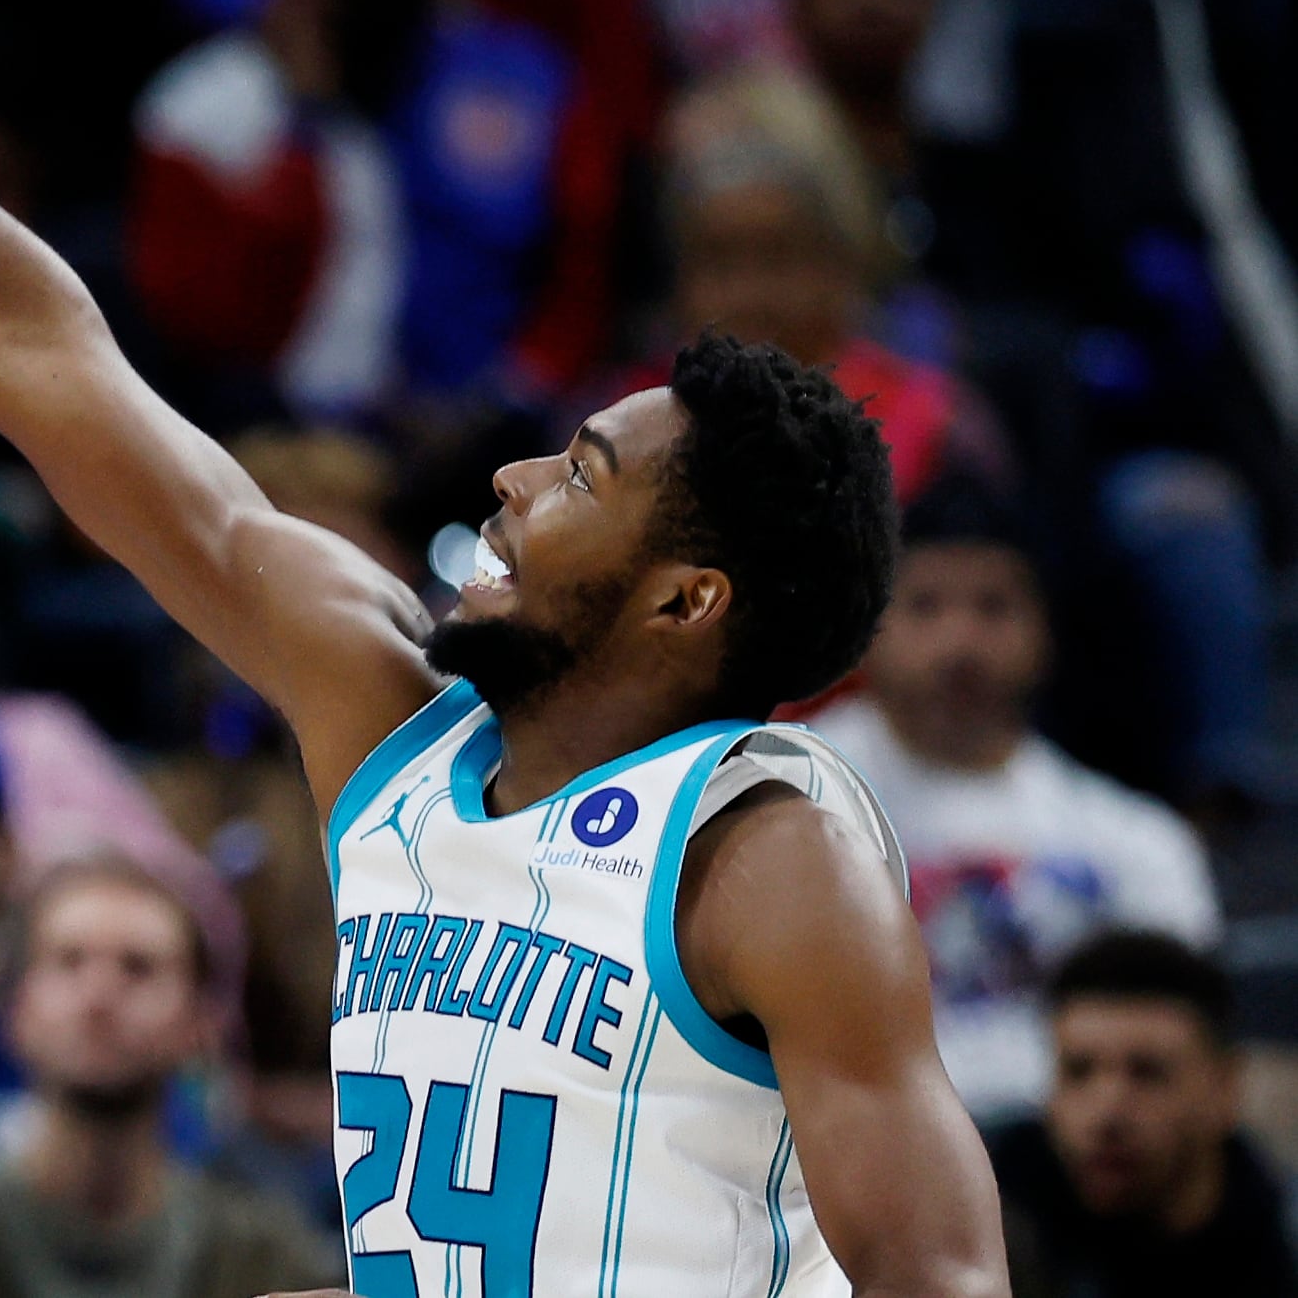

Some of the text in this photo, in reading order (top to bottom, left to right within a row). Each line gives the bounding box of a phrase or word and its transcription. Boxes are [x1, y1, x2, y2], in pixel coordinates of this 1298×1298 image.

[534, 847, 643, 879] Judi Health
[331, 912, 633, 1070] CHARLOTTE
[336, 1071, 558, 1298] 24
